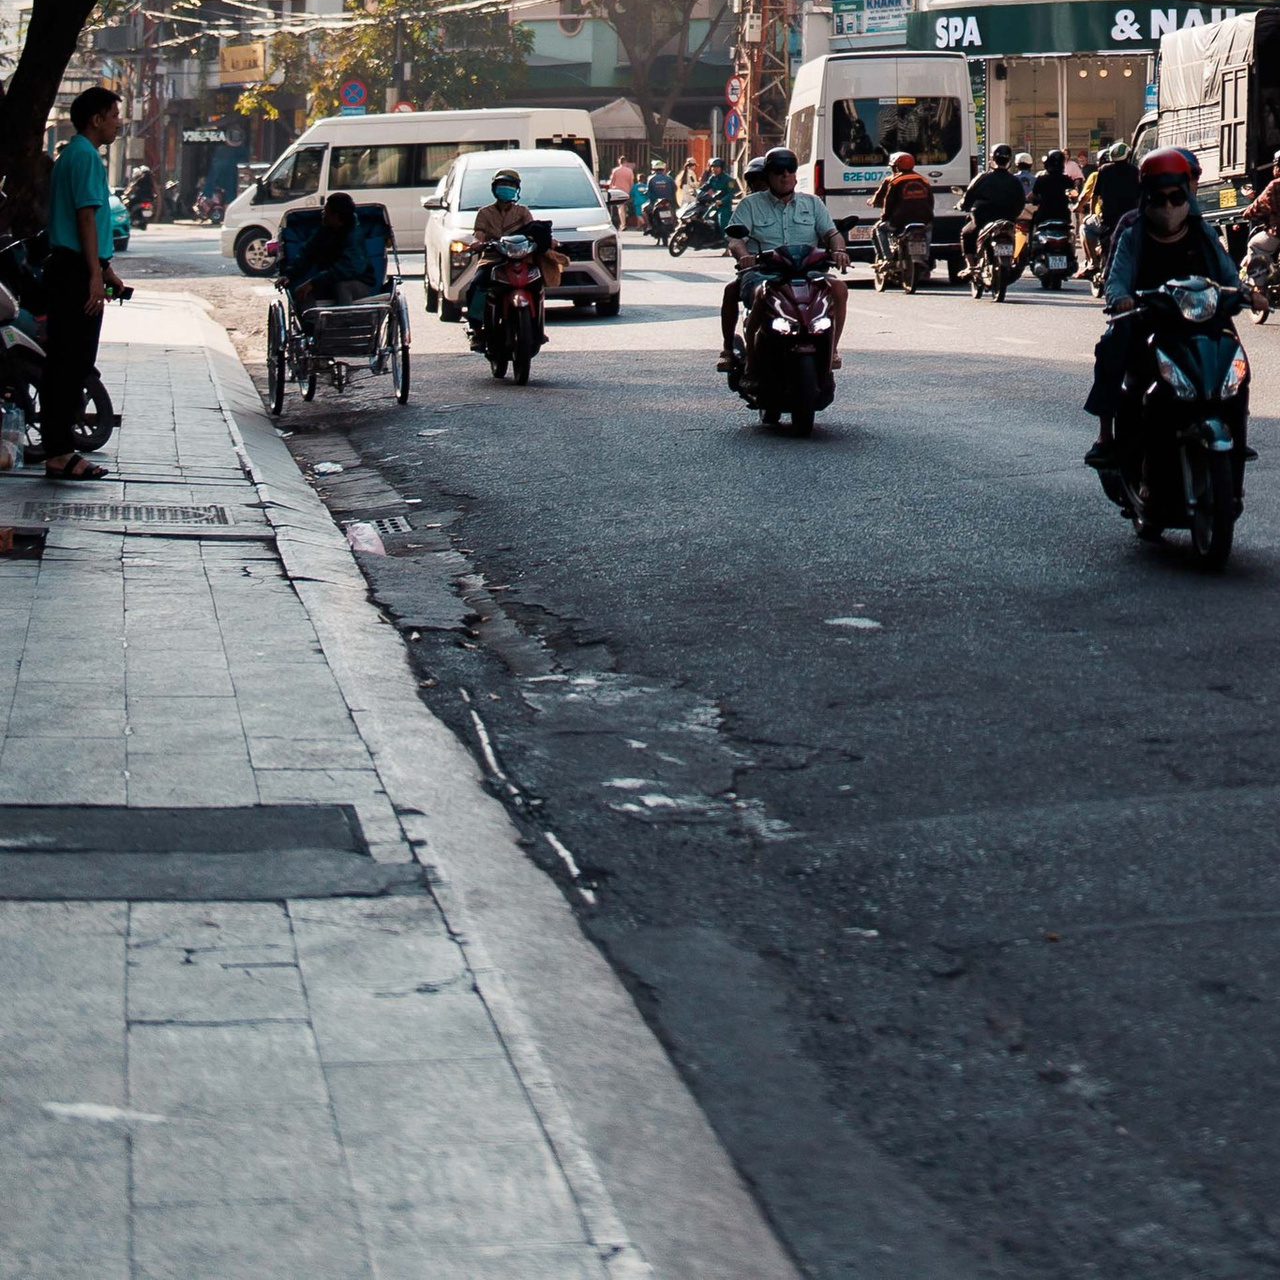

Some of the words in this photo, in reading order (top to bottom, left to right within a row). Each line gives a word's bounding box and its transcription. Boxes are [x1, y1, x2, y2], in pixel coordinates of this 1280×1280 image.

[935, 15, 982, 49] SPA
[1111, 10, 1143, 40] &
[1150, 7, 1236, 38] NAI
